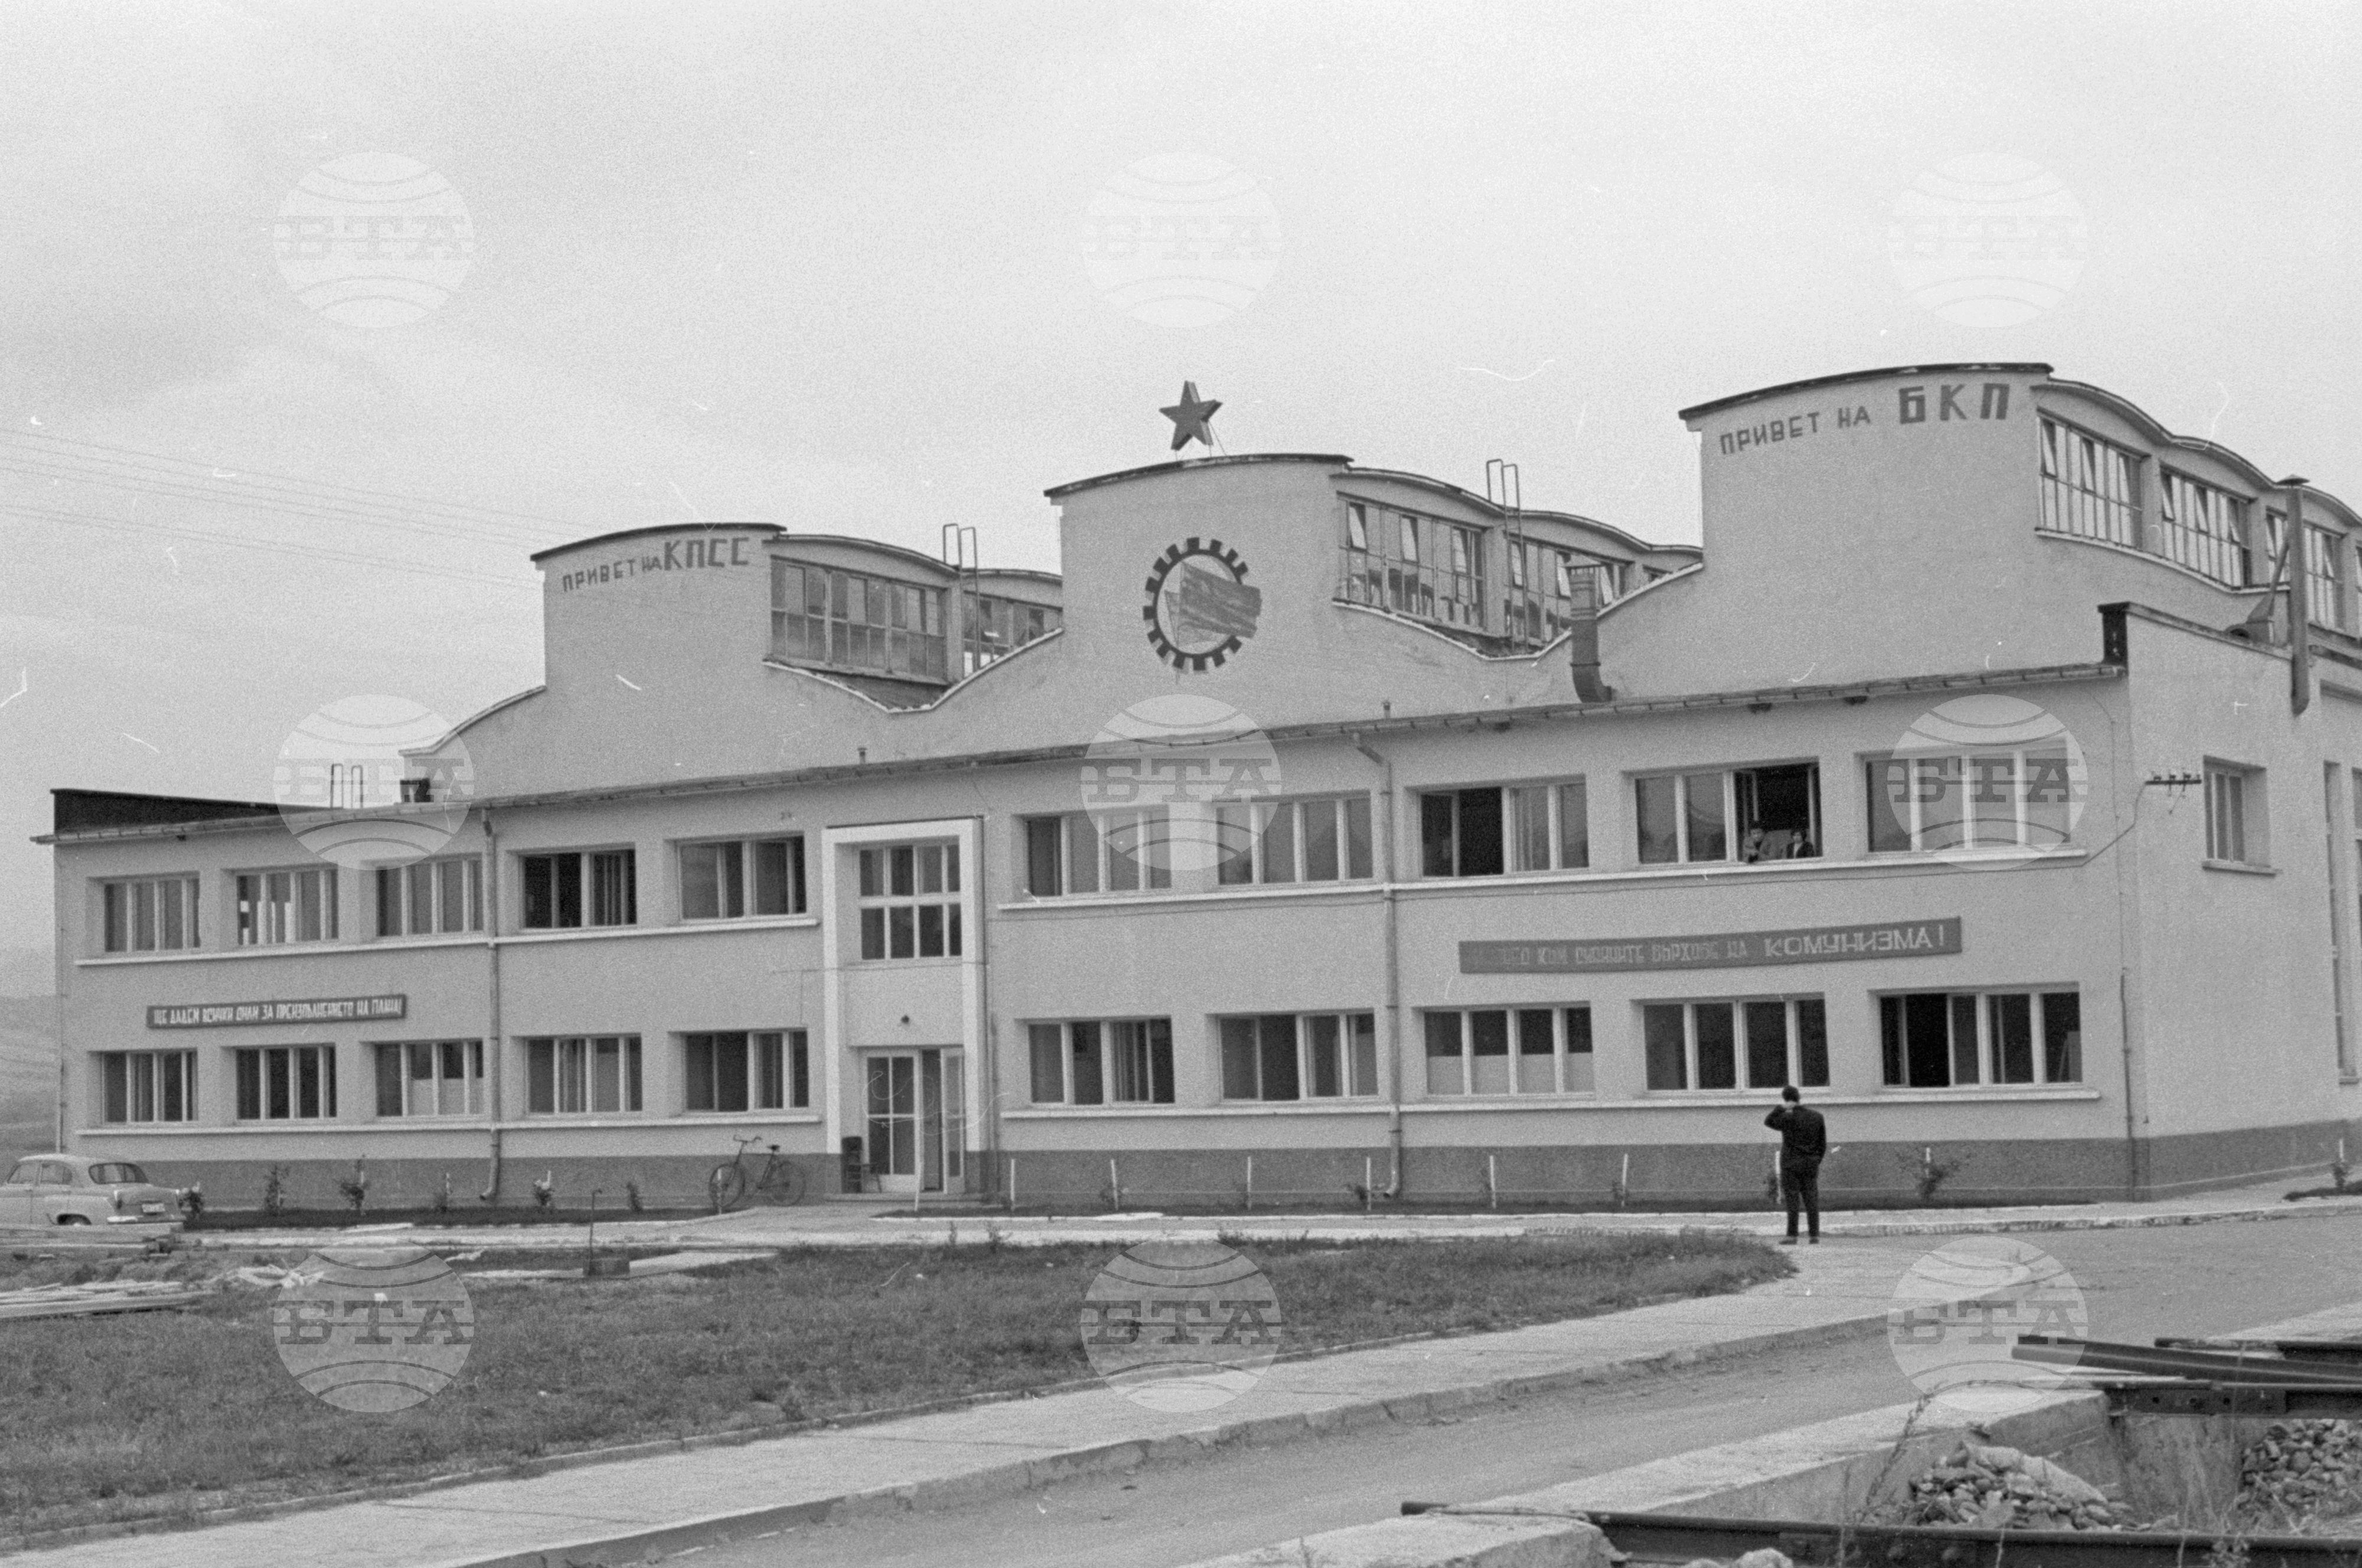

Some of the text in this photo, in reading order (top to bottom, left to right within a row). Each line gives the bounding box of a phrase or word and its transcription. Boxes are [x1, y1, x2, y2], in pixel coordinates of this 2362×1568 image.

[1719, 383, 2011, 455] ПРИВЕТ НА БКП
[563, 537, 749, 593] ПРИВЕТ НА КПСС
[1727, 939, 1748, 959] НА
[260, 1004, 273, 1020] ЗА
[356, 1000, 369, 1015] НА
